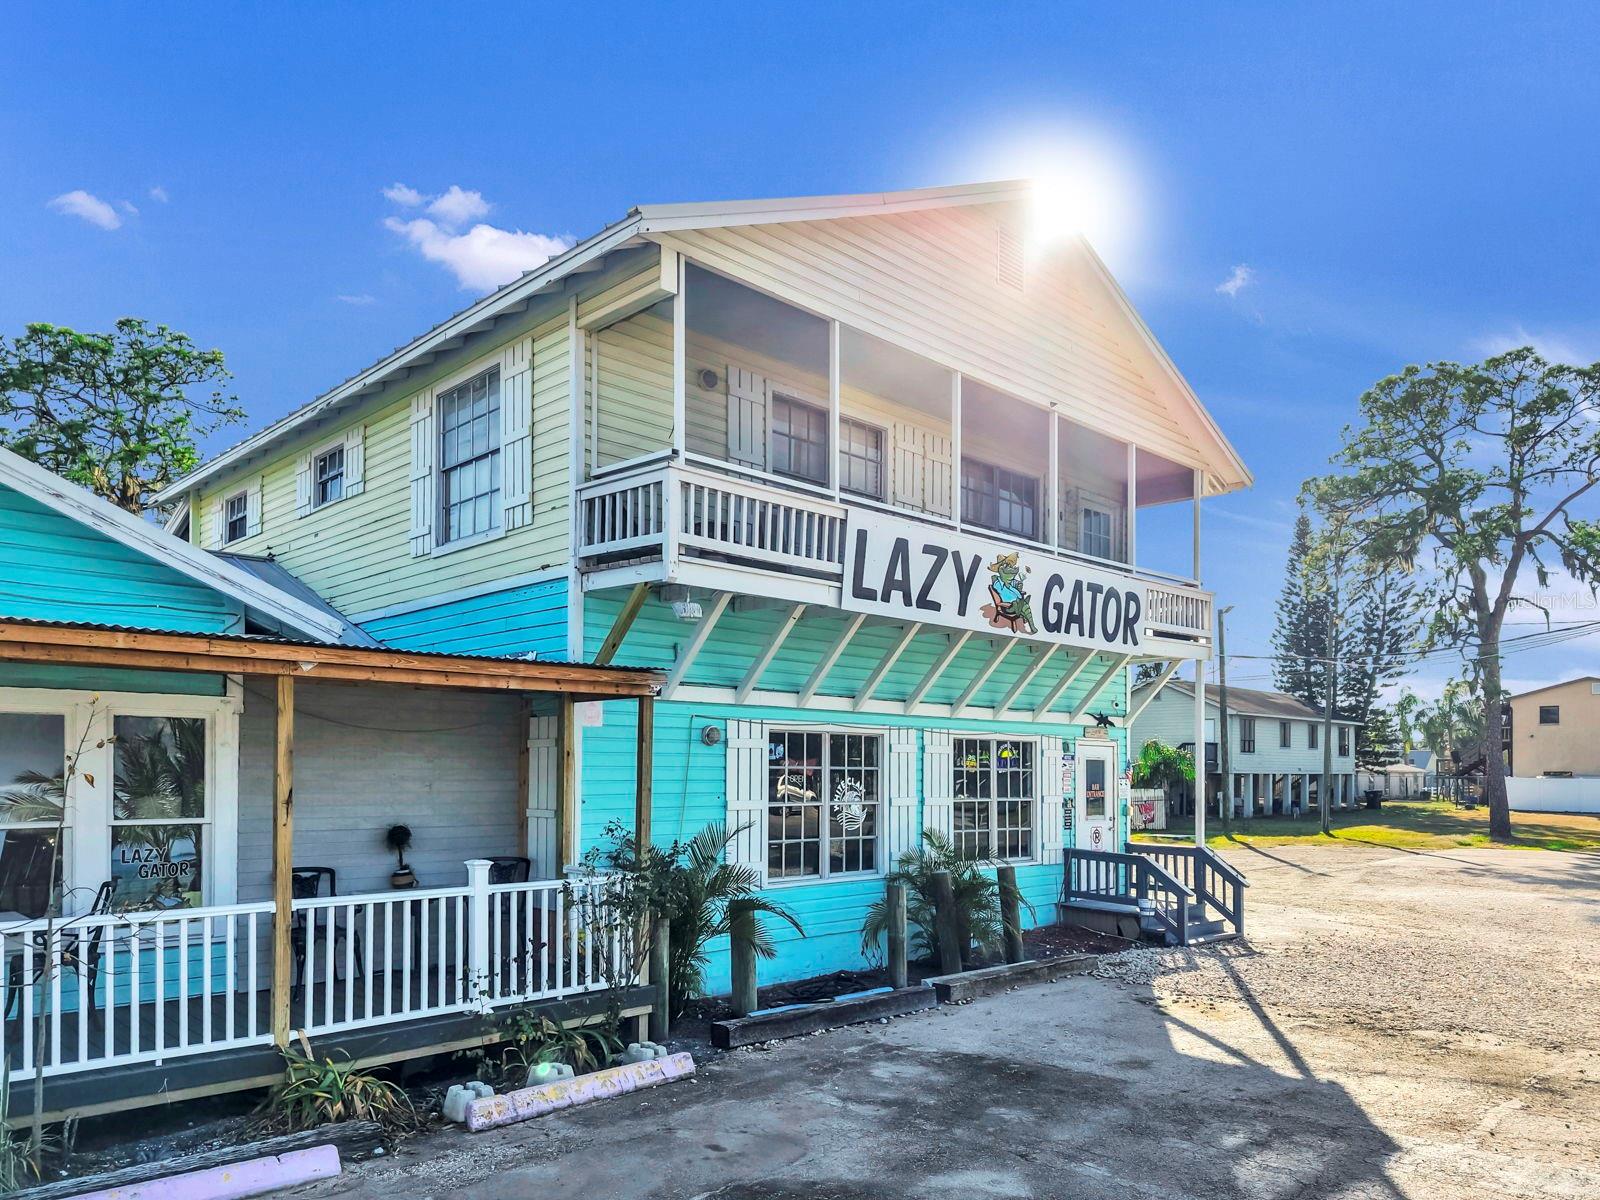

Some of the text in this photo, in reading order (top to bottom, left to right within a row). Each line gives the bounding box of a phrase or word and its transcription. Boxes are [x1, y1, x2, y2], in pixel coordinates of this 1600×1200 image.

[852, 528, 1142, 646] LAZY GATOR
[833, 780, 847, 812] WHITE
[121, 847, 168, 864] LAZY
[138, 861, 189, 880] GATOR
